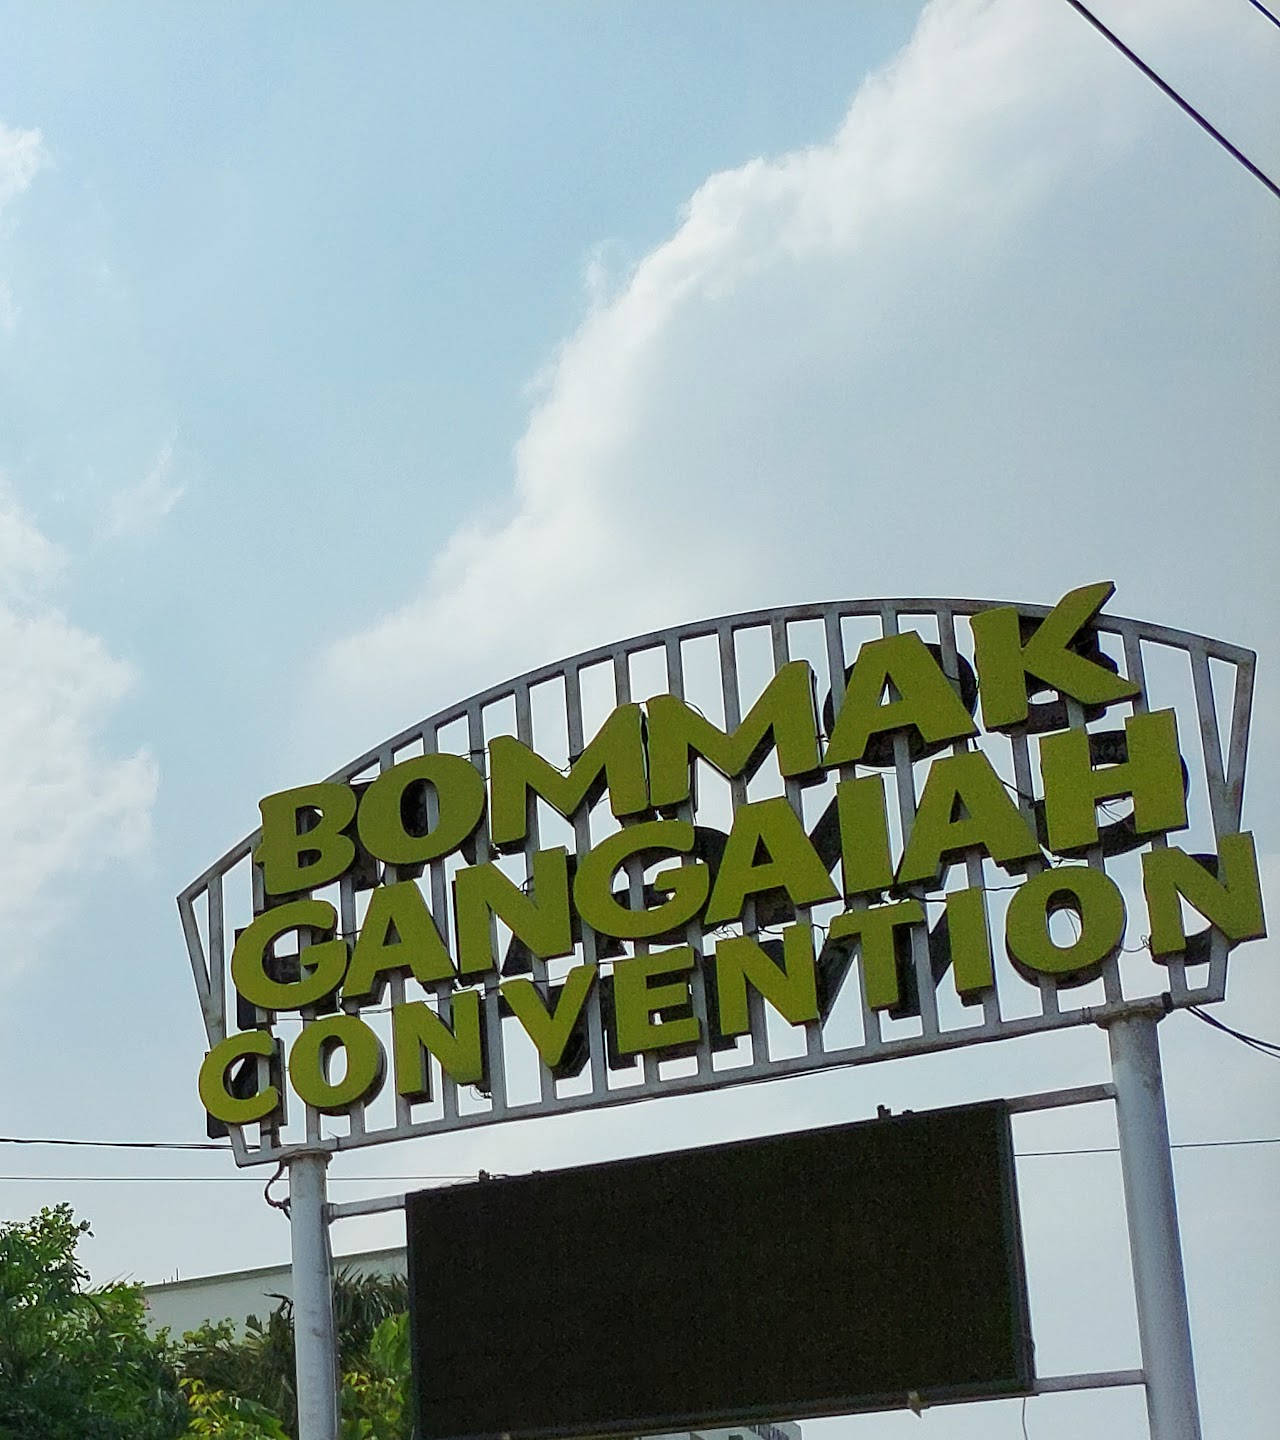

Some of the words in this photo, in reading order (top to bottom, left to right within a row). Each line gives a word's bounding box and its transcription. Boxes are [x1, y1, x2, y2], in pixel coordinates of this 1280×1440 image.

[231, 708, 1188, 1012] GANGAIAH
[256, 581, 1141, 896] BOMMAK
[197, 831, 1267, 1125] CONVENTION
